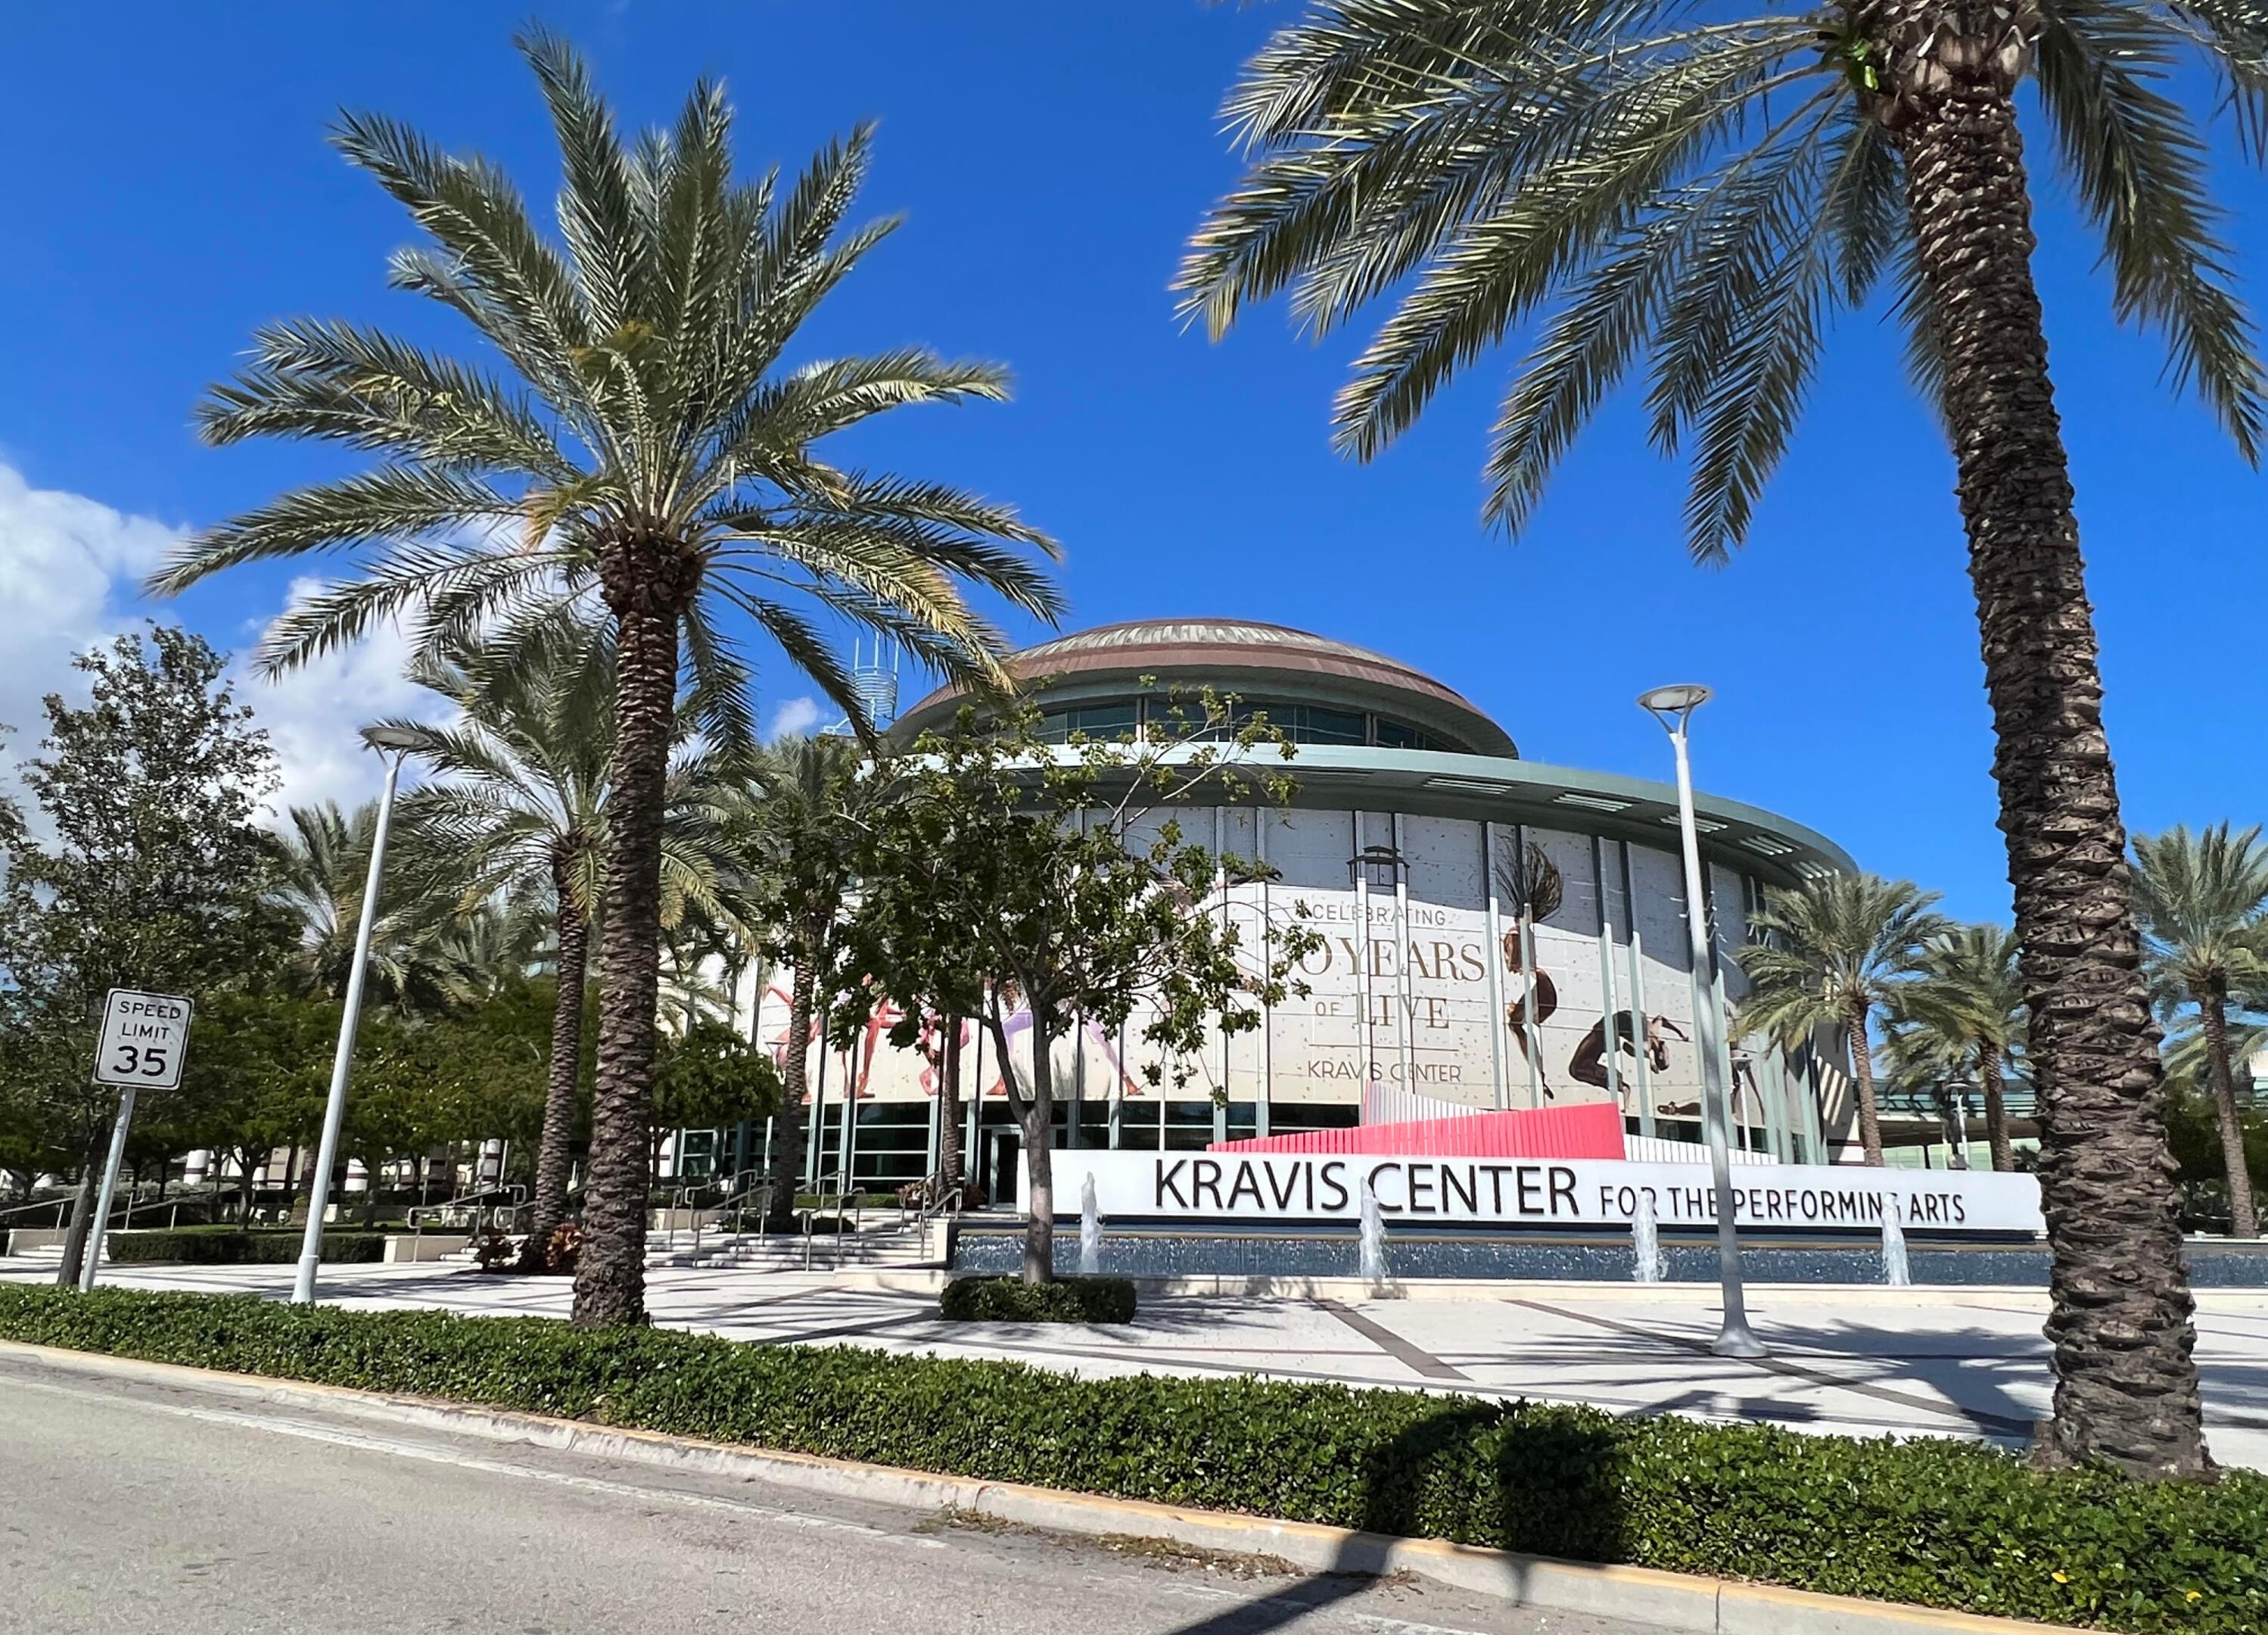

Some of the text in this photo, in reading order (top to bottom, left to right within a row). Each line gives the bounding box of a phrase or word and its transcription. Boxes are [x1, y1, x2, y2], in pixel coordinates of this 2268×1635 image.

[1335, 937, 1485, 982] YEARS
[118, 1001, 181, 1020] SPEED
[1315, 1001, 1340, 1017] OF
[1352, 993, 1449, 1029] LIVE
[121, 1023, 170, 1039] LIMIT
[113, 1045, 167, 1076] 35
[1308, 1060, 1462, 1082] KRAVS CENTER
[1155, 1159, 1348, 1210] KRAVIS
[1367, 1162, 1579, 1215] CENTER
[1600, 1185, 1658, 1216] FOR
[1666, 1187, 1719, 1218] THE
[1909, 1193, 1965, 1222] ARTS
